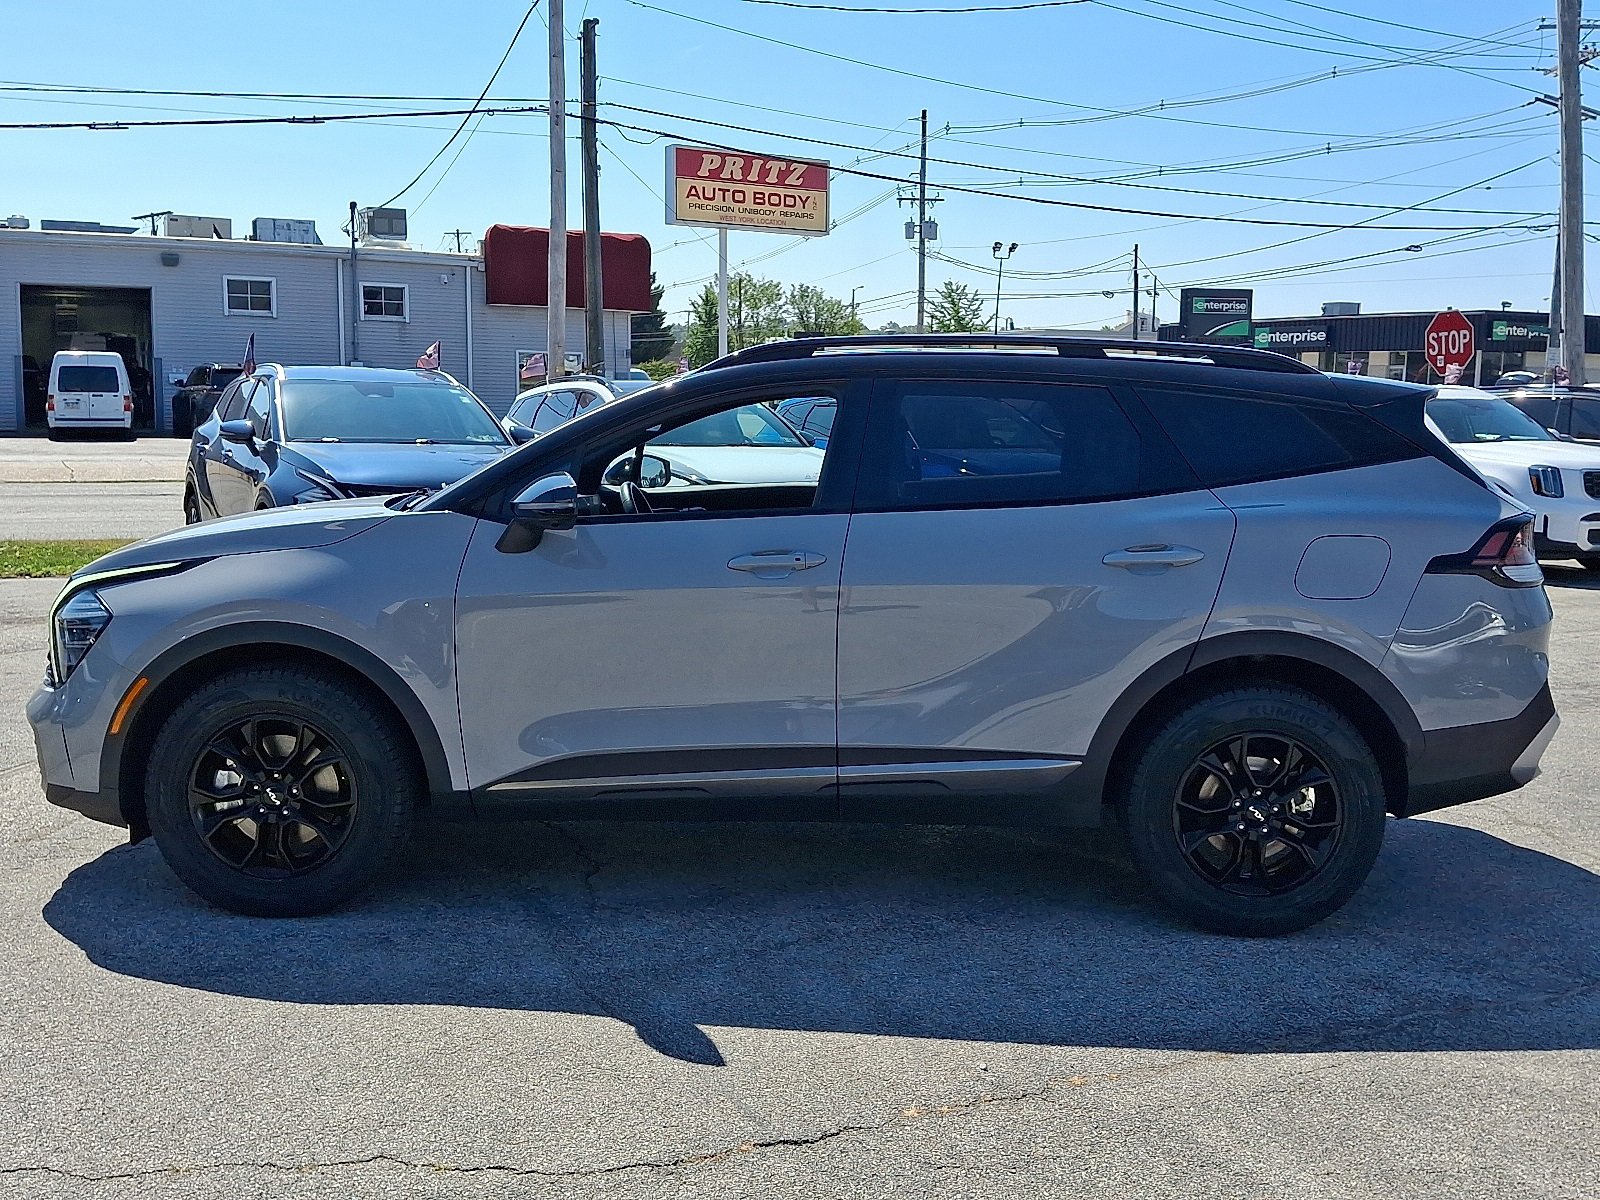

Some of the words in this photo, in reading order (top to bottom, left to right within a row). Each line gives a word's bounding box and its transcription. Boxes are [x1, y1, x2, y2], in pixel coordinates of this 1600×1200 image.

[697, 153, 809, 186] PRITZ
[686, 185, 746, 204] AUTO
[753, 191, 811, 210] BODY
[688, 202, 735, 213] PRECISION
[738, 207, 776, 217] UNIBODY
[780, 210, 815, 220] REPAIRS
[719, 214, 737, 222] WEST
[738, 216, 755, 224] YORK
[757, 218, 787, 226] LOCATION
[1196, 300, 1247, 312] enterprise
[1257, 329, 1327, 345] enterprise
[1428, 329, 1470, 356] STOP
